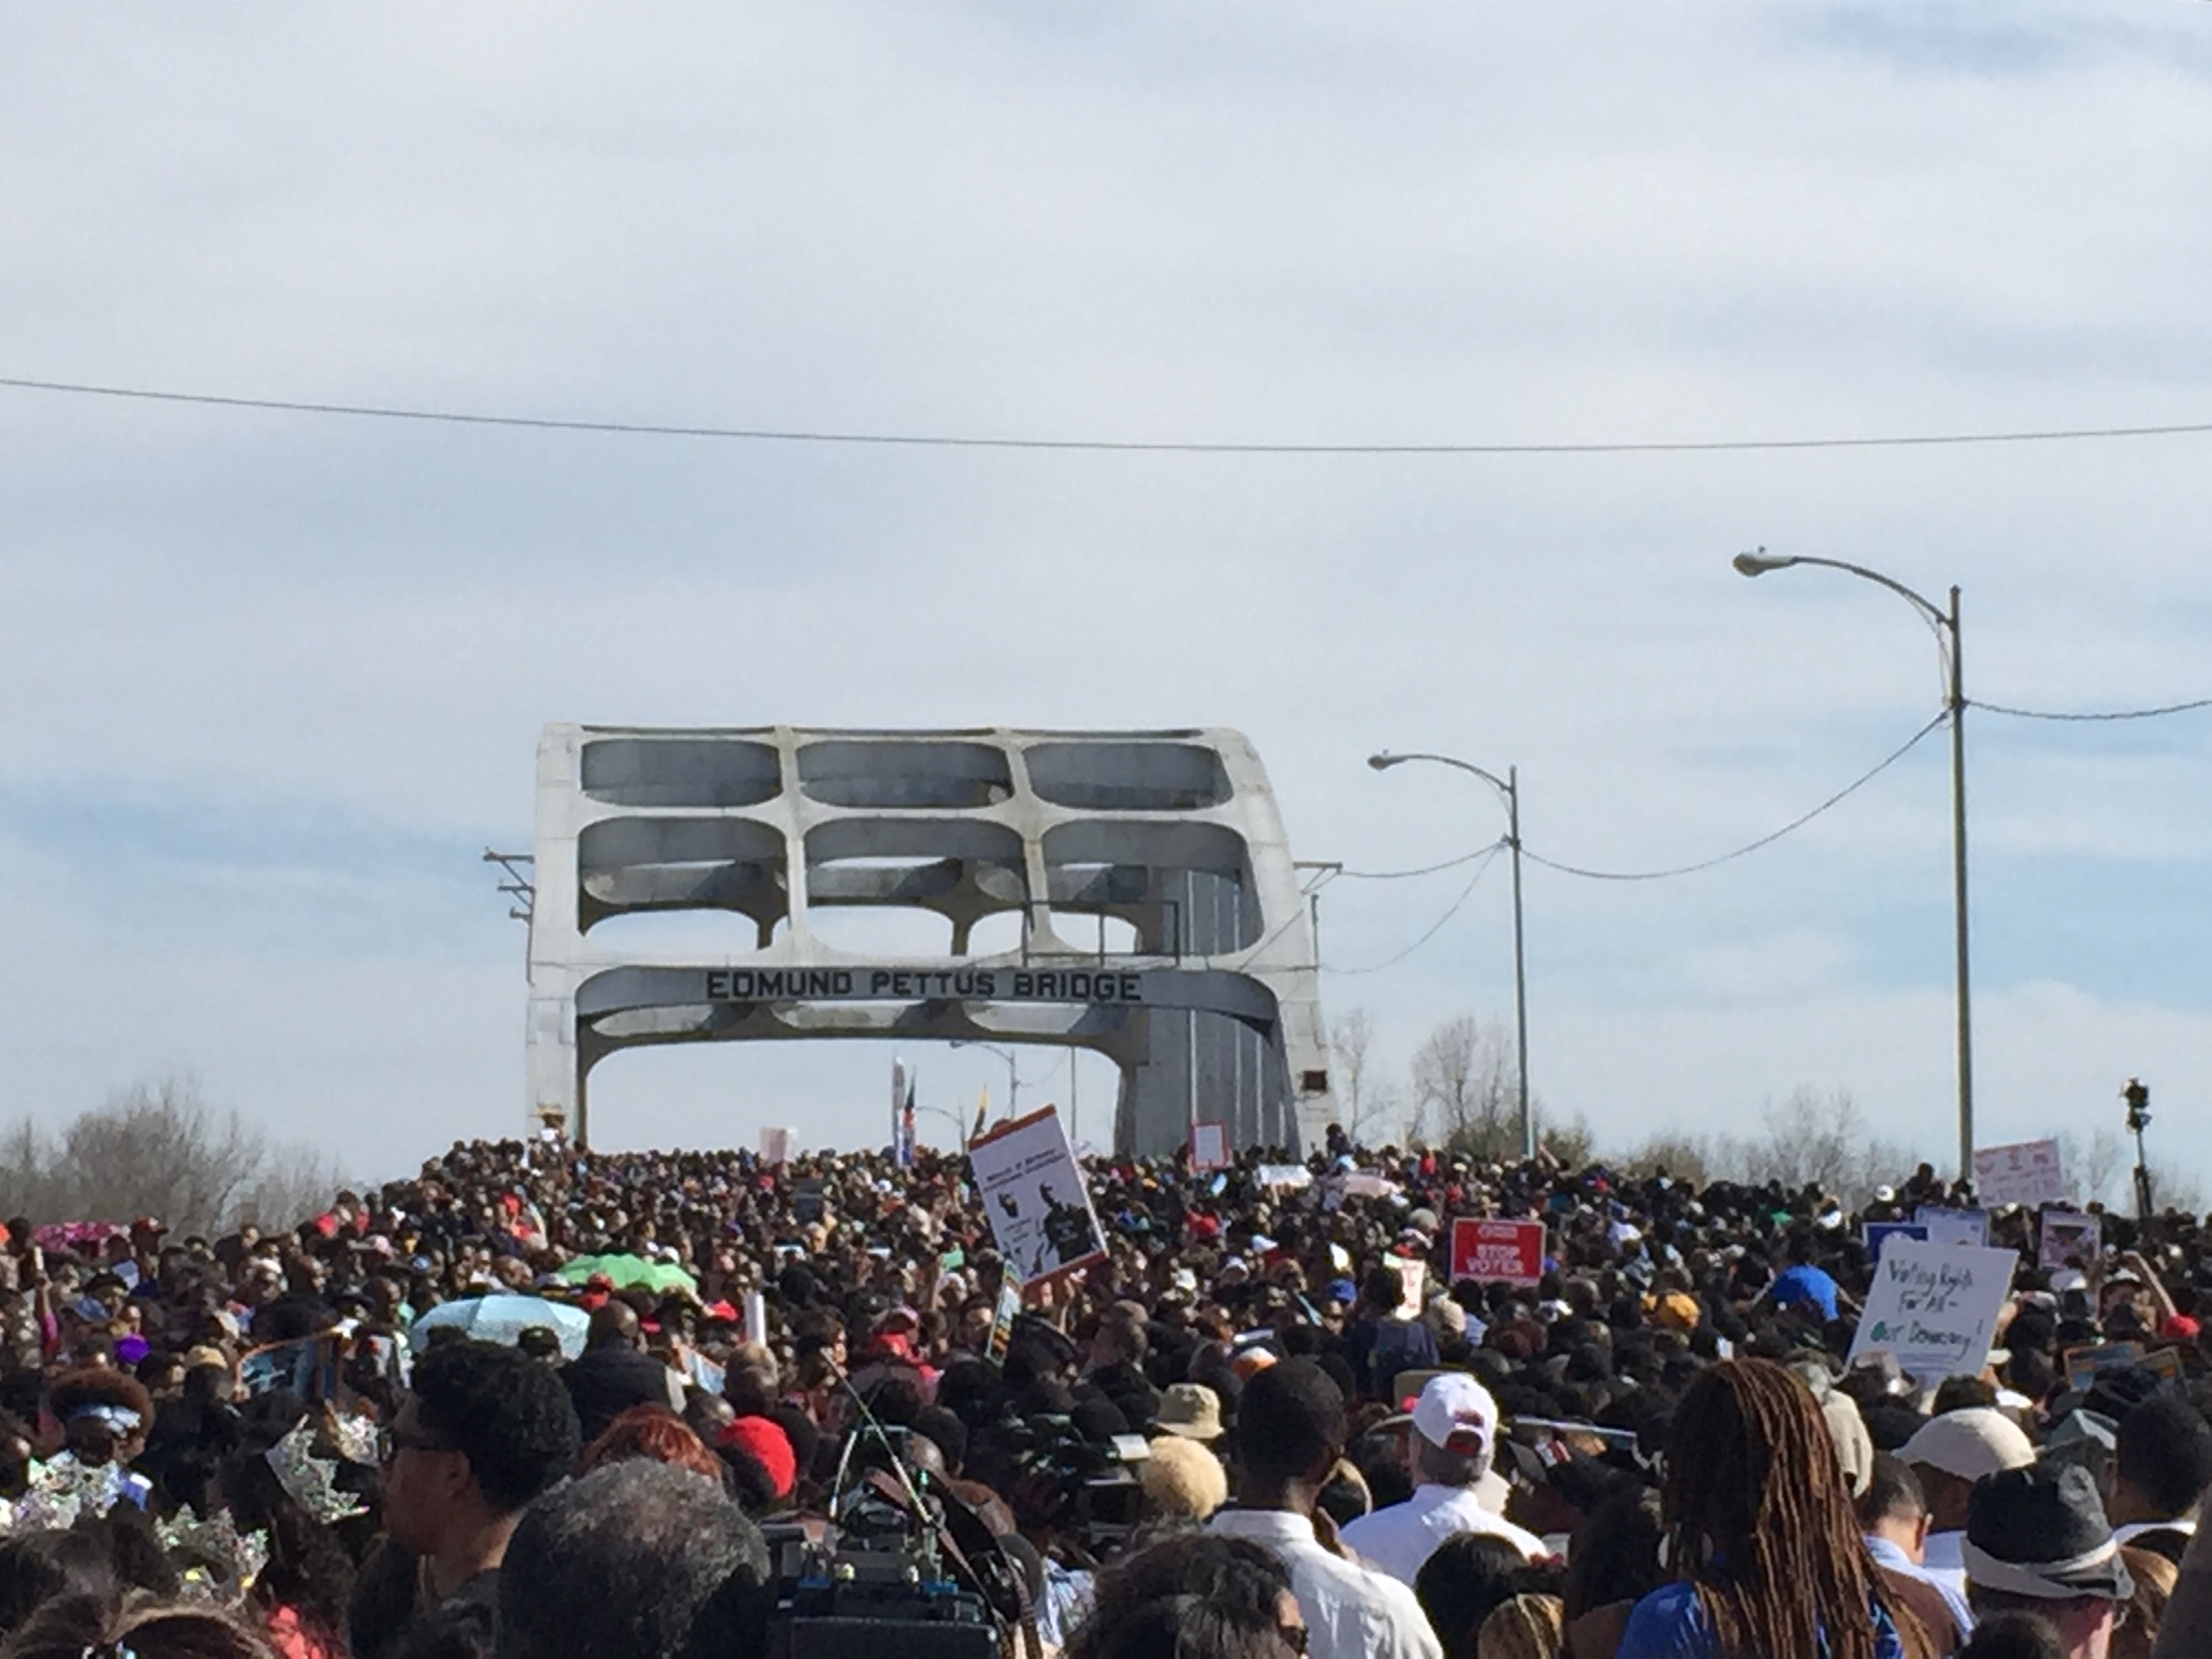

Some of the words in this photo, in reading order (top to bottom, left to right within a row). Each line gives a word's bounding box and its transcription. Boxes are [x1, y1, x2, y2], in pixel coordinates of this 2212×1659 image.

[706, 972, 852, 999] EDMUND
[871, 972, 996, 997] PETTUS
[1014, 972, 1141, 1000] BRIDGE
[1476, 1244, 1520, 1259] STOP
[1888, 1259, 1936, 1296] Voting
[1898, 1290, 1923, 1314] For
[1870, 1320, 1905, 1342] Our
